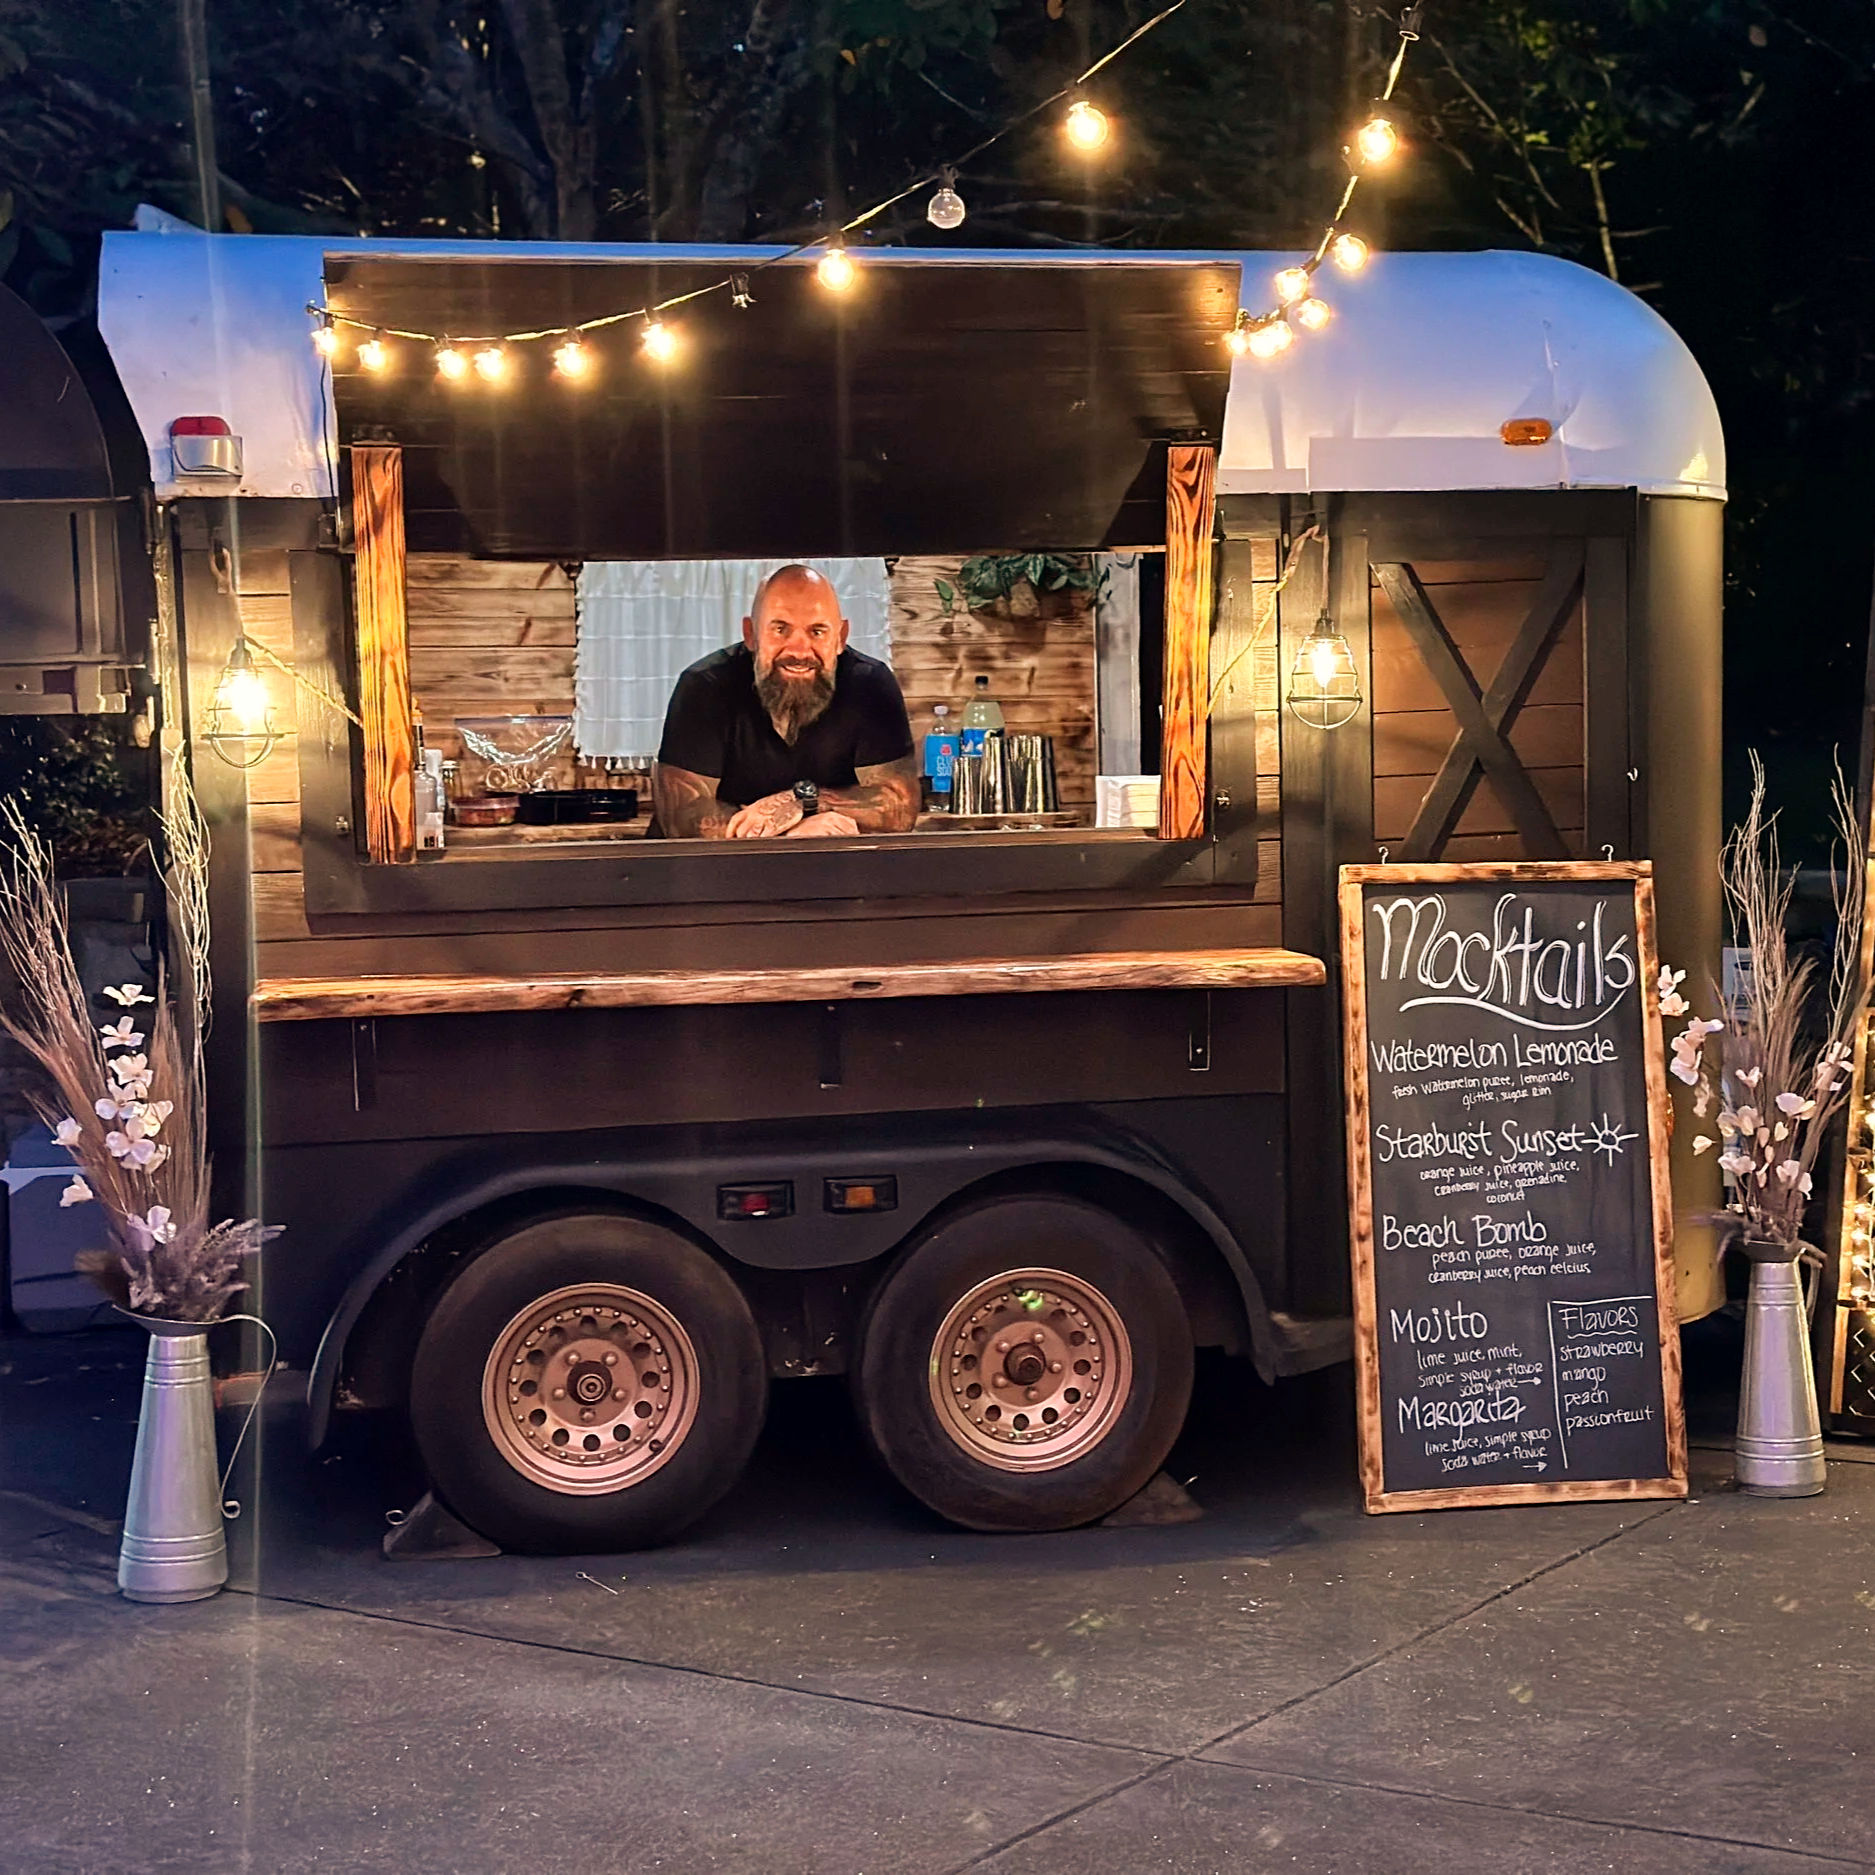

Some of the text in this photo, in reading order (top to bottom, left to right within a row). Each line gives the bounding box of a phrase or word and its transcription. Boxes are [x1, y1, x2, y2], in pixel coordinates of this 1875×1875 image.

[1372, 892, 1635, 1009] Mocktails
[1371, 1032, 1618, 1073] Watermelon Lemonade
[1520, 1069, 1574, 1086] lemonade,
[1375, 1119, 1585, 1164] Starburst Sunset
[1493, 1159, 1545, 1181] pineapple
[1383, 1210, 1548, 1250] Beach Bomb
[1432, 1249, 1471, 1271] peach
[1518, 1244, 1559, 1263] orange
[1513, 1264, 1546, 1282] peach
[1390, 1300, 1488, 1344] Mojito
[1558, 1306, 1639, 1331] Flavors
[1416, 1349, 1446, 1370] lime
[1560, 1341, 1644, 1362] strawberry
[1562, 1366, 1607, 1391] mango
[1564, 1389, 1609, 1413] peach
[1398, 1388, 1527, 1441] Margarita
[1425, 1441, 1450, 1456] lime
[1484, 1431, 1518, 1448] simple
[1441, 1455, 1469, 1473] soda
